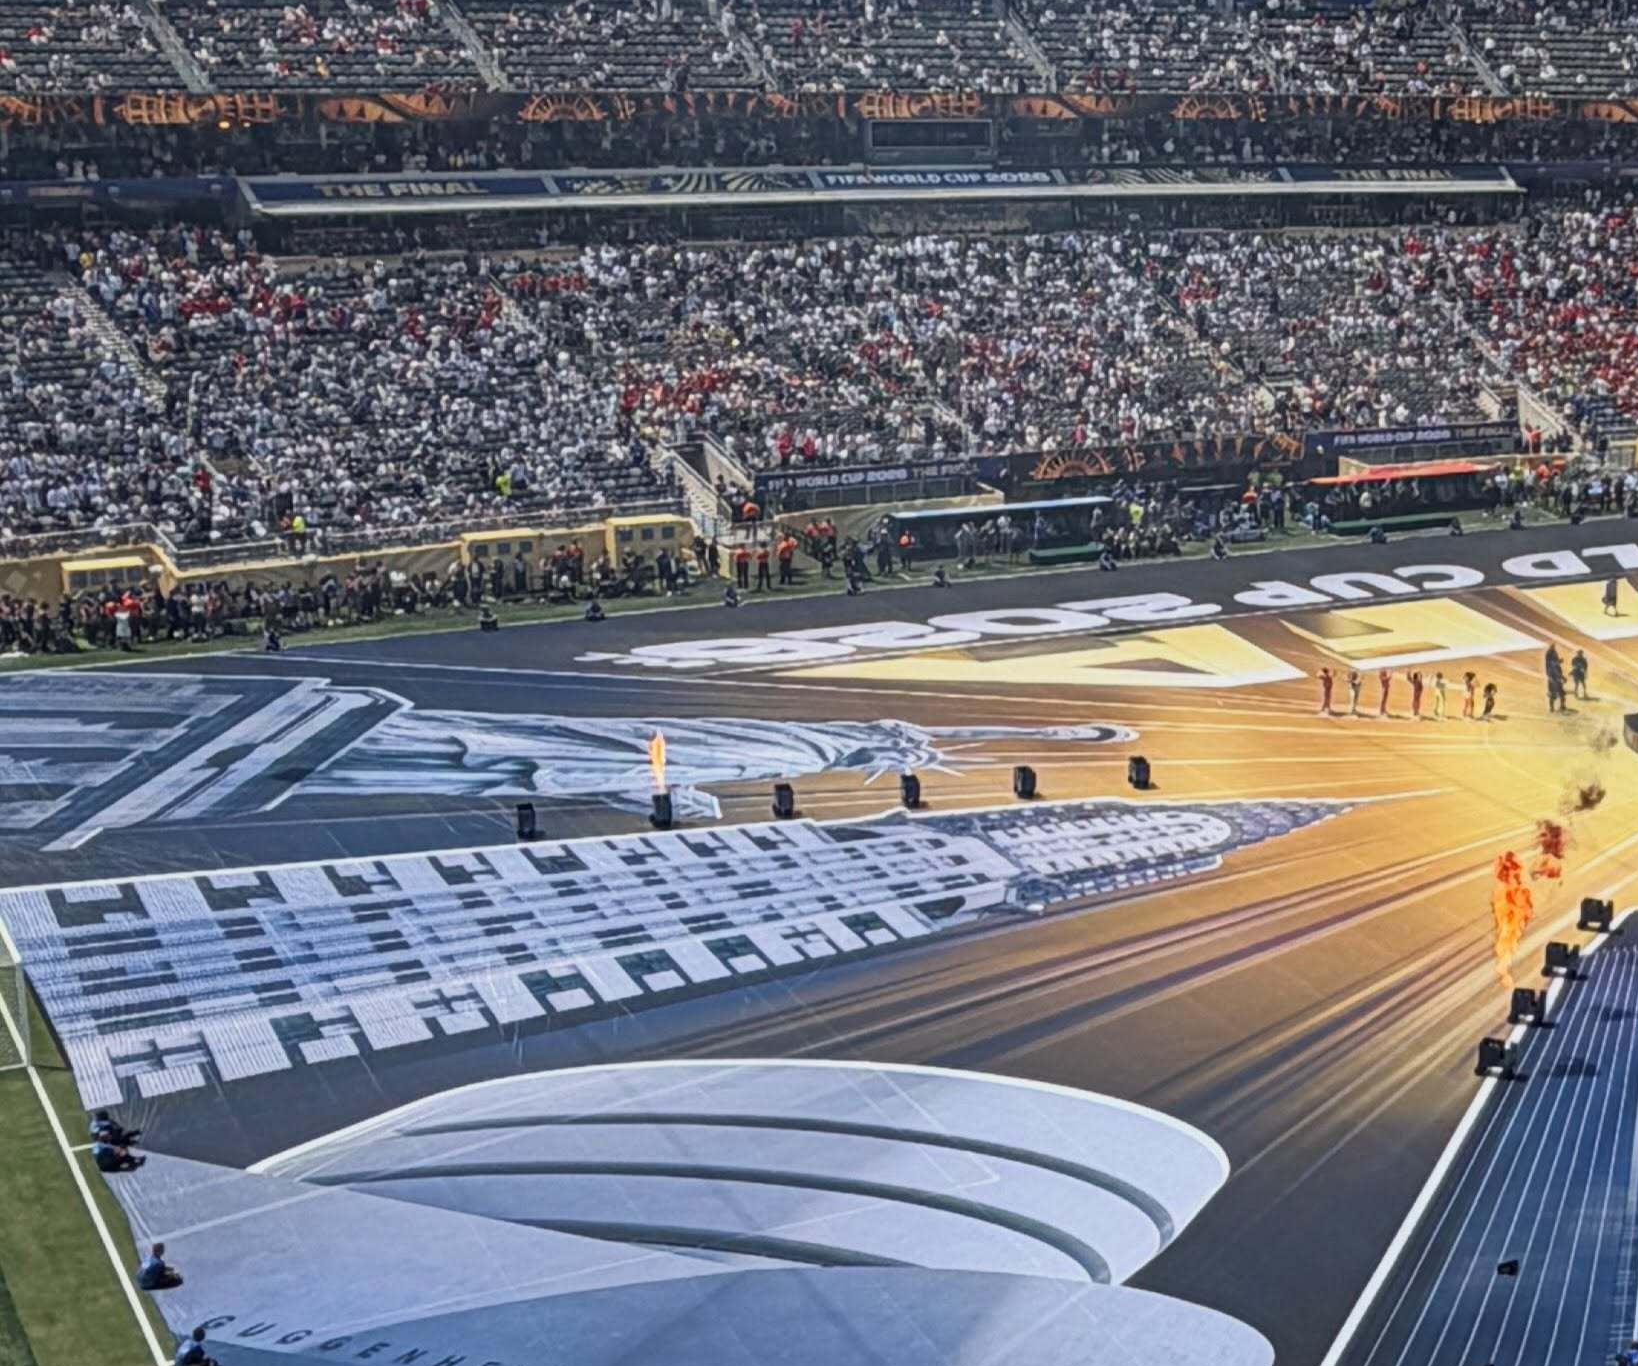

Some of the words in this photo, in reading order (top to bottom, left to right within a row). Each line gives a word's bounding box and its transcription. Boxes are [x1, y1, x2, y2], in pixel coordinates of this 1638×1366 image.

[873, 173, 942, 186] WORLD
[944, 173, 982, 184] CUP
[317, 183, 386, 199] THE
[387, 181, 489, 198] FINAL
[796, 474, 839, 488] WORLD
[840, 472, 865, 485] CUP
[1233, 562, 1487, 609] CUP
